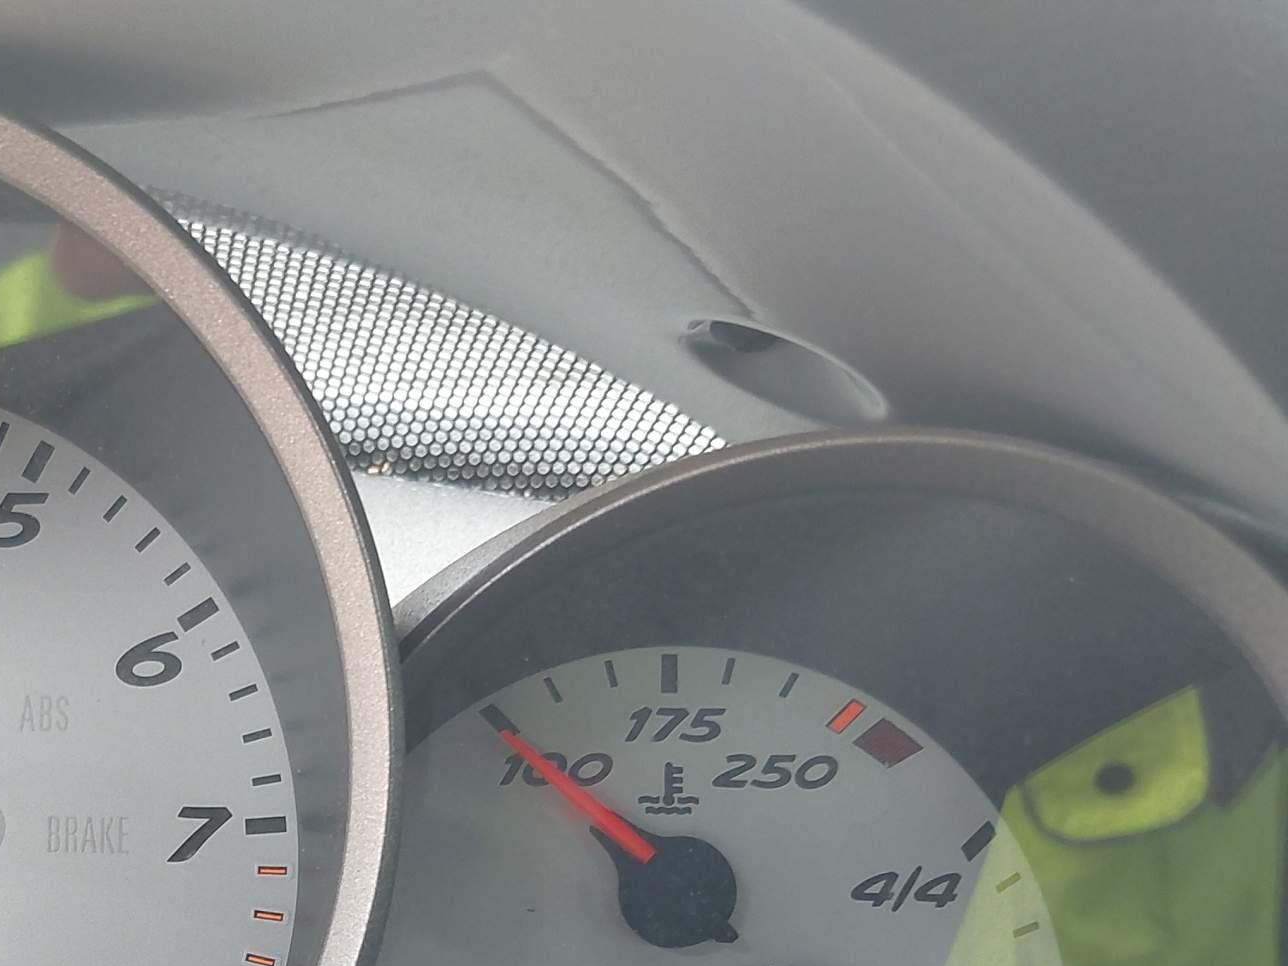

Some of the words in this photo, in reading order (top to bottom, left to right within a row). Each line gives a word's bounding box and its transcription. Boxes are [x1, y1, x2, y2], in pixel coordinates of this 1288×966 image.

[115, 631, 183, 687] 6
[18, 695, 70, 732] ABS
[624, 707, 726, 743] 175
[499, 753, 613, 787] 100
[713, 754, 839, 789] 250
[47, 815, 130, 855] BRAKE
[167, 806, 232, 863] 7
[851, 865, 962, 911] 4/4
